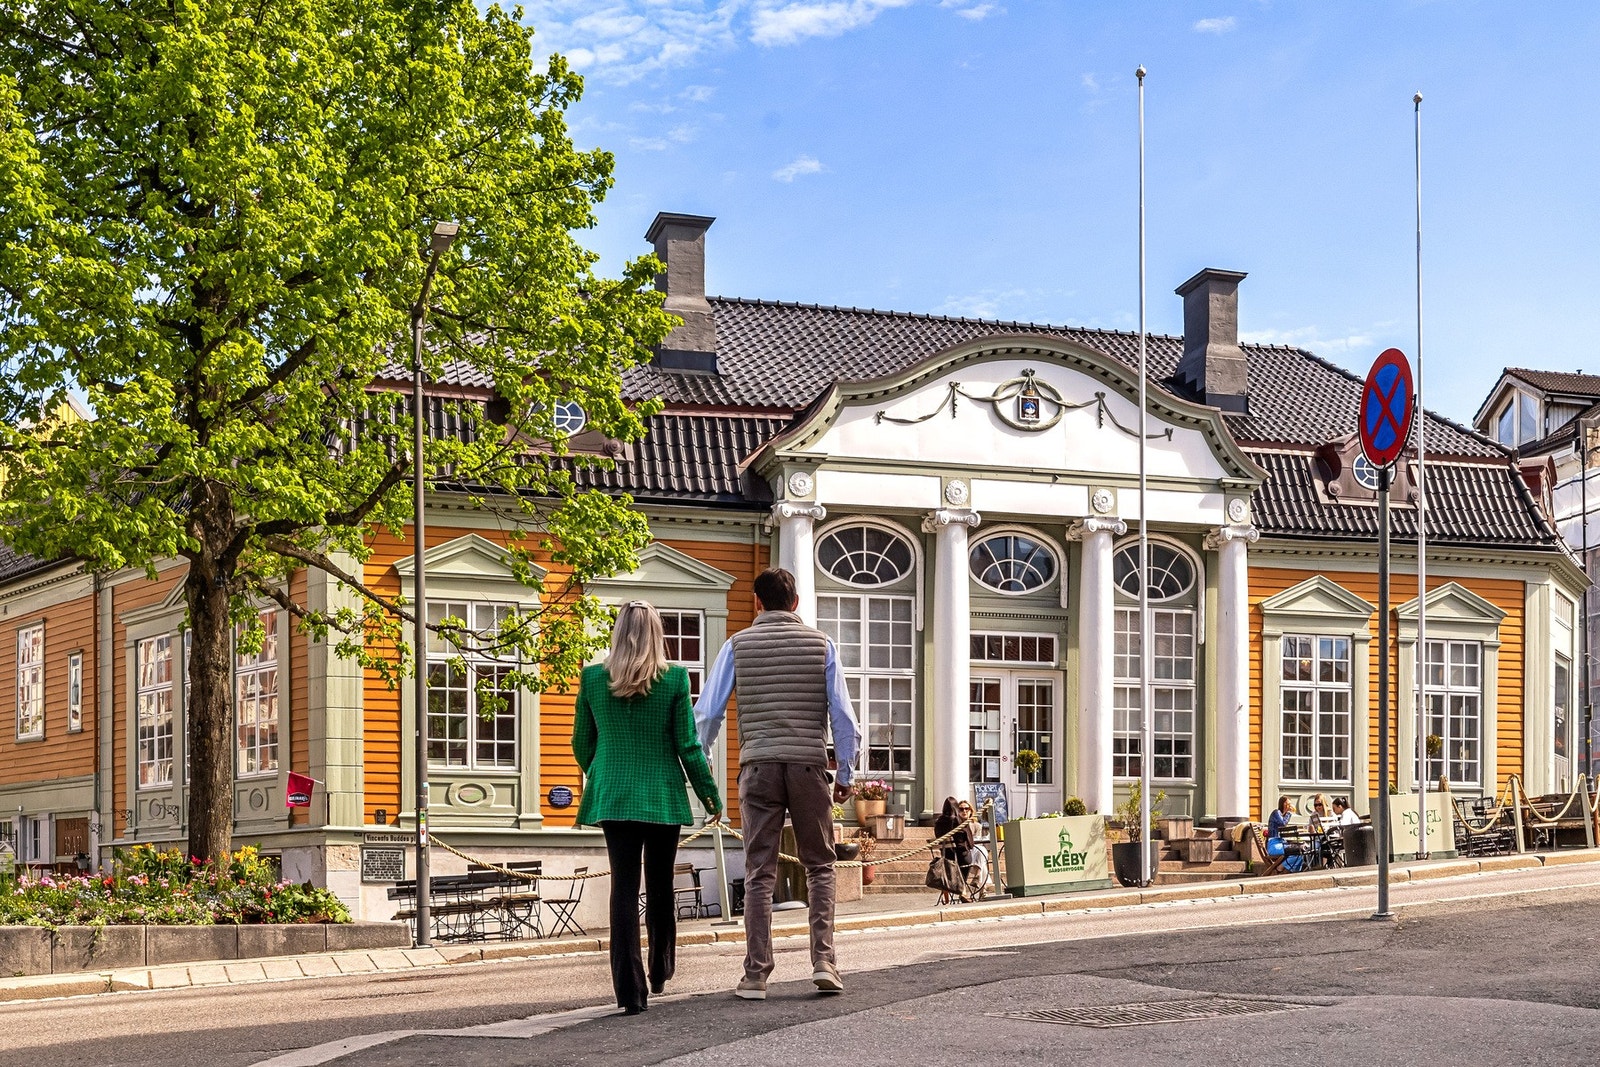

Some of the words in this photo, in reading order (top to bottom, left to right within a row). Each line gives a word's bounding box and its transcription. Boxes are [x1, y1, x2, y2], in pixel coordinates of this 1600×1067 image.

[1402, 809, 1442, 825] NOEL
[366, 834, 389, 842] Vincents
[1043, 852, 1088, 868] EKEBY
